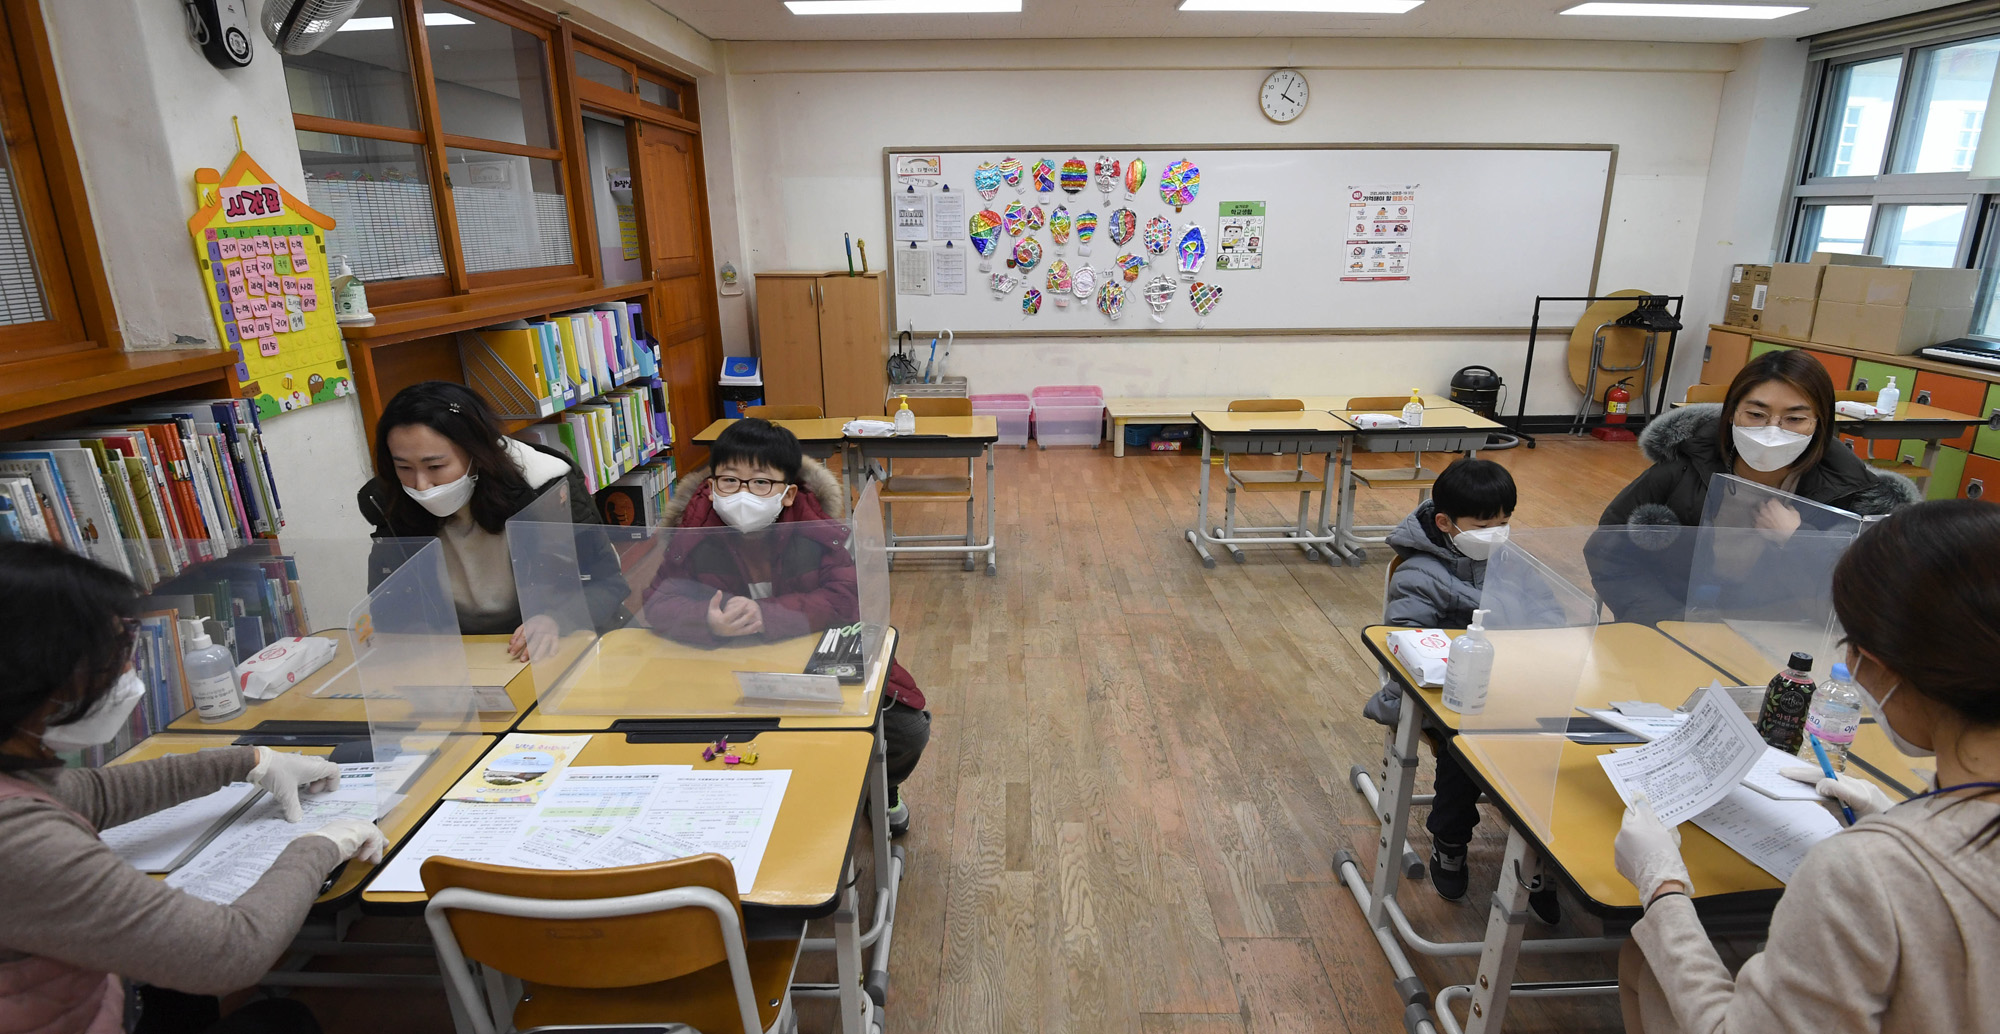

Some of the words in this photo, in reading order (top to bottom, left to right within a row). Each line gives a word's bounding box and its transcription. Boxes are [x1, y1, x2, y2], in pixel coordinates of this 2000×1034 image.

[222, 244, 236, 254] 국어
[241, 244, 254, 253] 국어
[257, 241, 270, 250] 수학
[260, 261, 273, 270] 국어
[284, 280, 296, 289] 영어
[300, 282, 313, 290] 사회
[232, 286, 245, 296] 영어
[258, 323, 270, 331] 미술
[275, 318, 287, 327] 국어
[262, 341, 277, 350] 미술
[1776, 713, 1799, 723] 아티제
